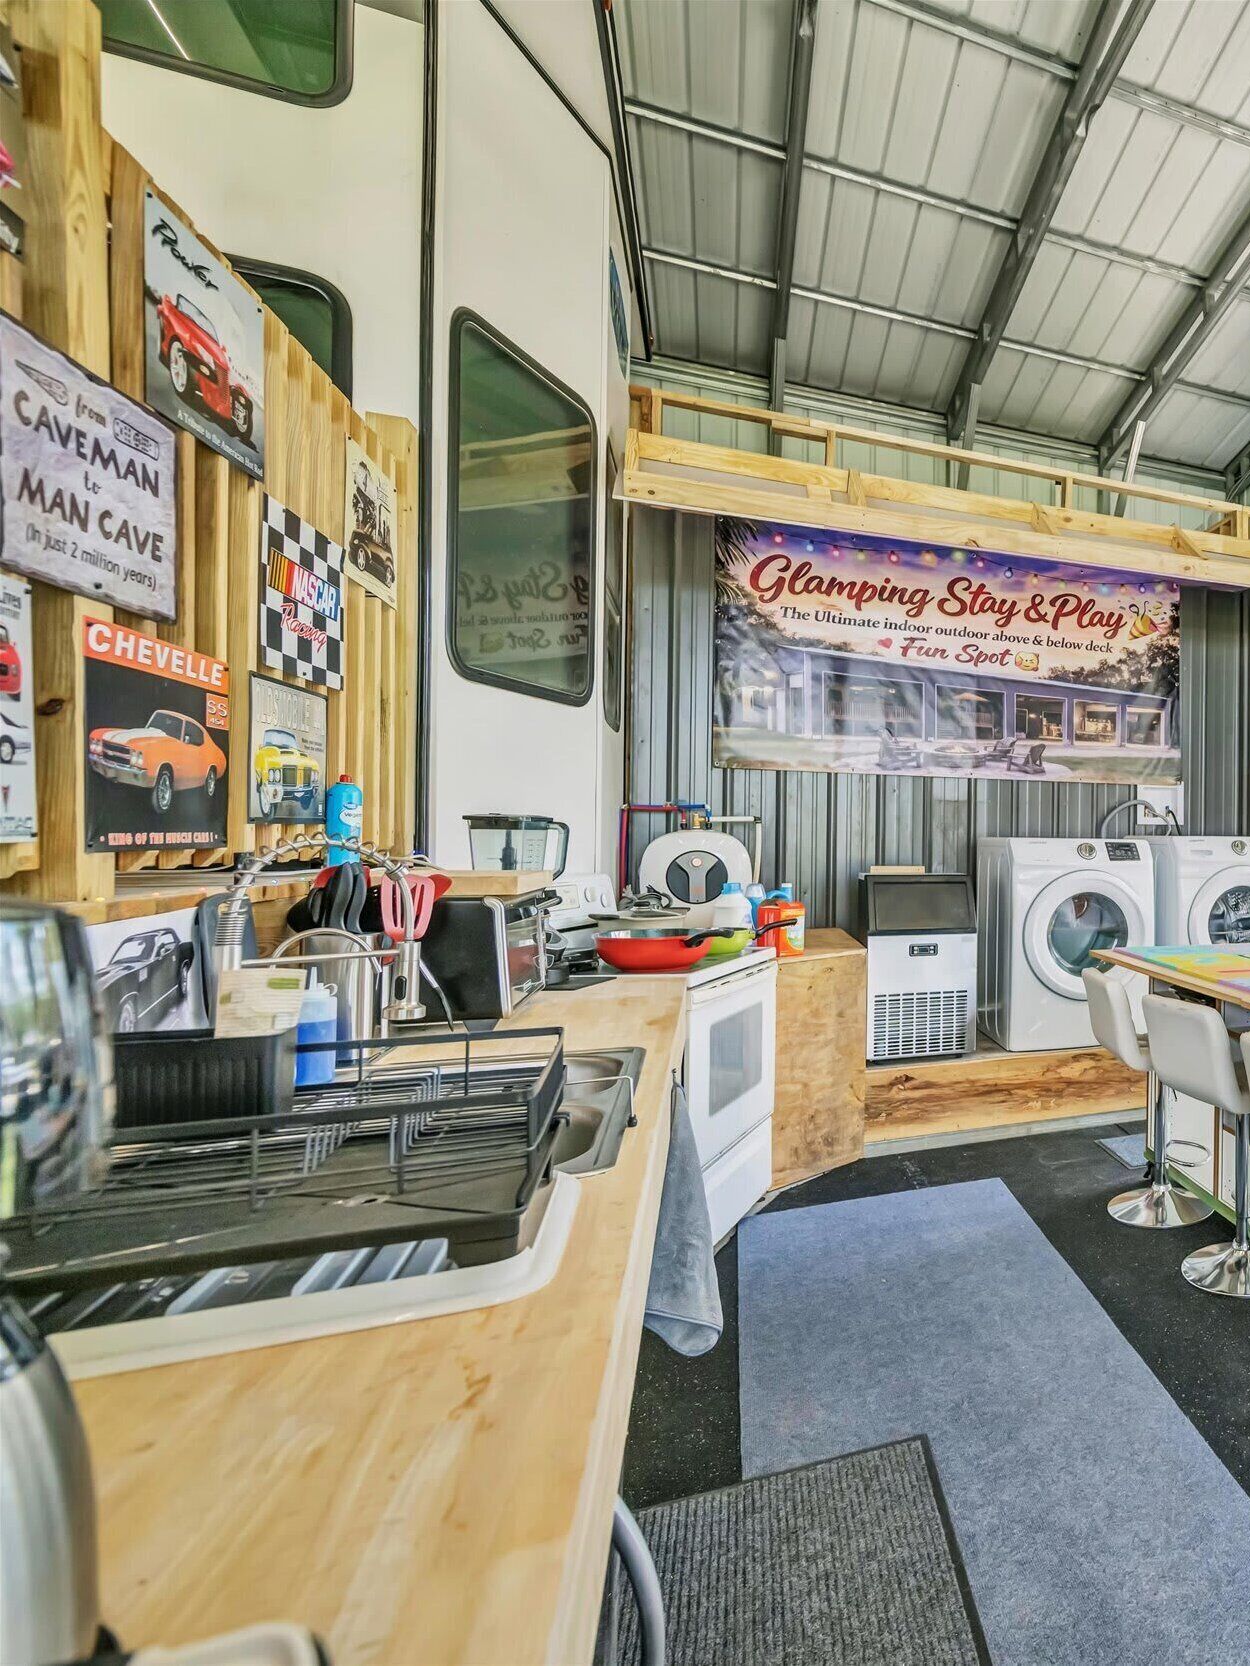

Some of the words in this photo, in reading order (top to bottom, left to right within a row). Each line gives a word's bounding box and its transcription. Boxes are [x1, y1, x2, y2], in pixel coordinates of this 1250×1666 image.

[151, 217, 219, 292] Prowler
[76, 394, 106, 428] from
[14, 390, 159, 498] CAVEMAN
[83, 471, 101, 494] to
[17, 467, 90, 533] MAN
[98, 509, 164, 563] CAVE
[43, 529, 68, 555] just
[70, 542, 79, 559] 2
[80, 549, 121, 576] million
[122, 566, 157, 592] years)
[292, 564, 337, 619] NASCAR
[750, 553, 936, 618] Glamping
[937, 576, 1021, 628] Stay
[88, 623, 225, 687] CHEVELLE
[280, 602, 328, 653] Racing
[780, 605, 811, 621] The
[814, 610, 880, 629] Ultimate
[884, 617, 933, 634] indoor
[935, 625, 991, 642] outdoor
[992, 631, 1030, 645] above
[1032, 634, 1043, 646] &
[1046, 636, 1084, 650] below
[1085, 639, 1113, 654] deck
[900, 637, 949, 659] Fun
[955, 643, 1013, 668] Spot
[208, 700, 227, 717] SS
